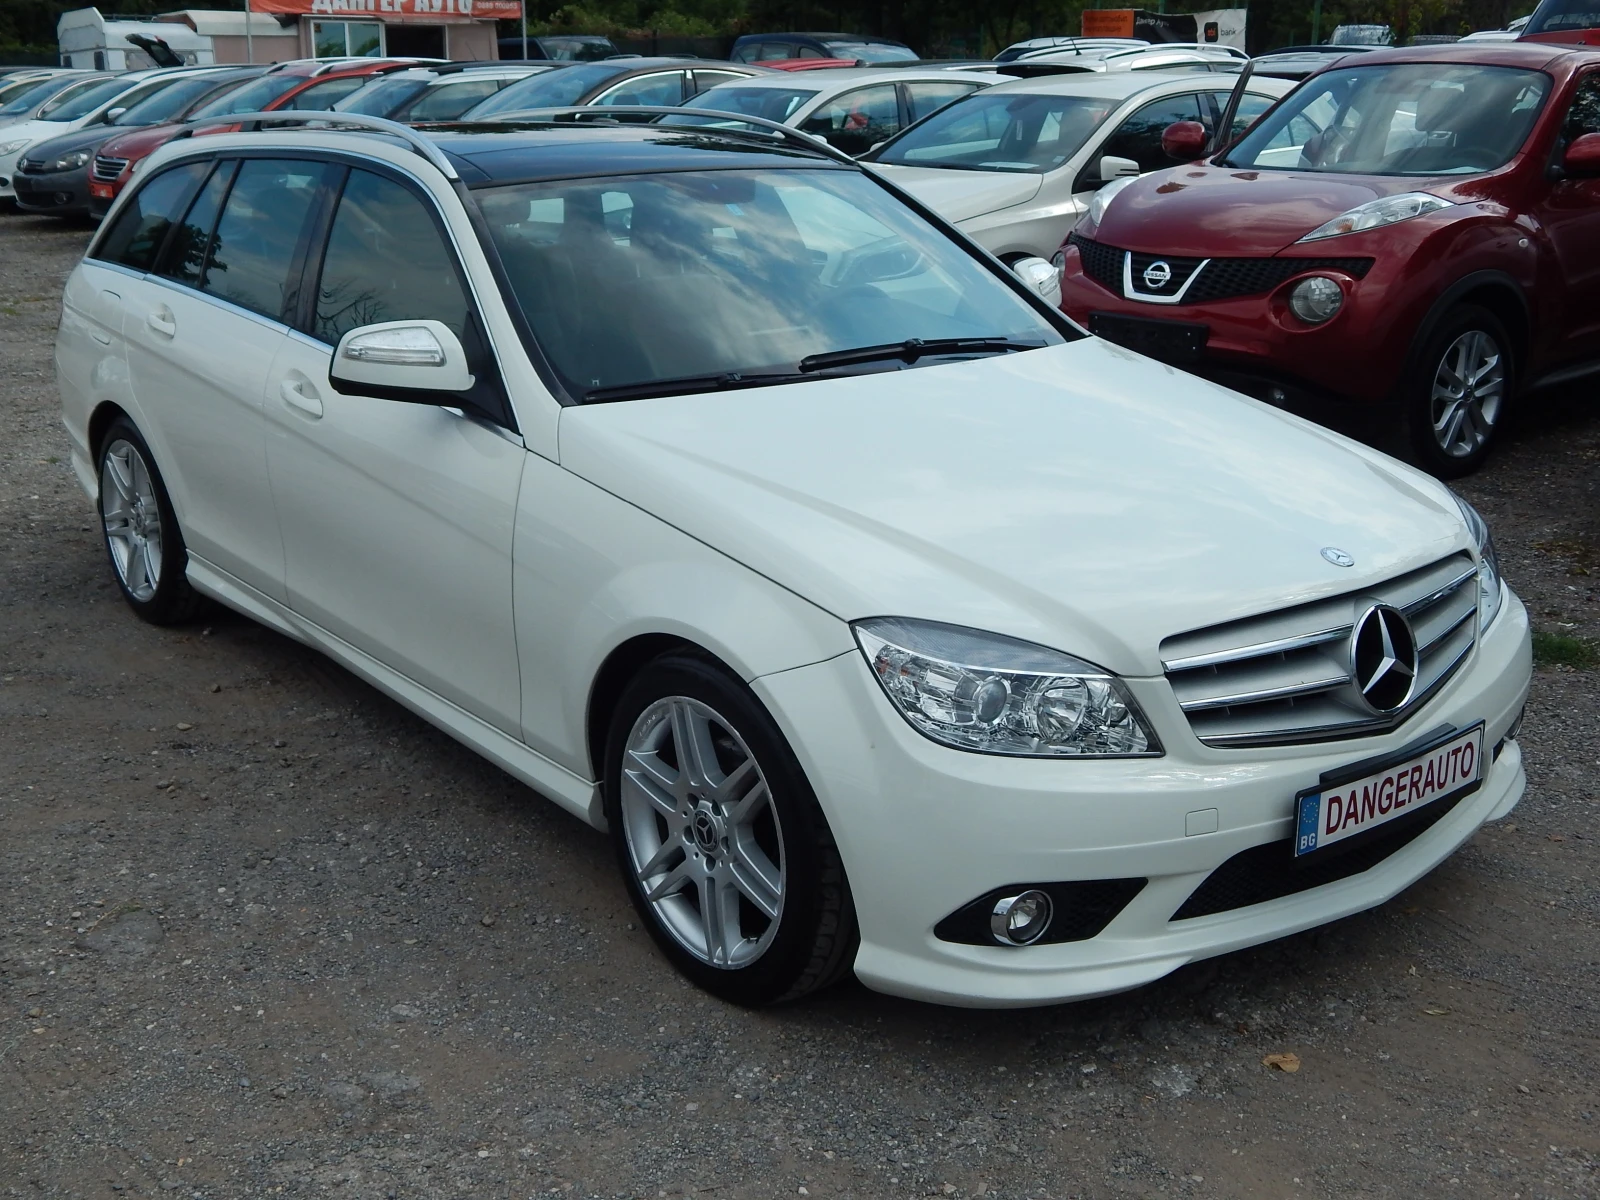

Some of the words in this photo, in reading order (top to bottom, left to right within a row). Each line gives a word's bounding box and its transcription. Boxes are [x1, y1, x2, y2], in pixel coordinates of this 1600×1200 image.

[1220, 28, 1237, 36] bank
[1144, 271, 1168, 279] NISSAN
[1325, 741, 1475, 836] DANGERAUTO
[1300, 832, 1316, 850] BG
